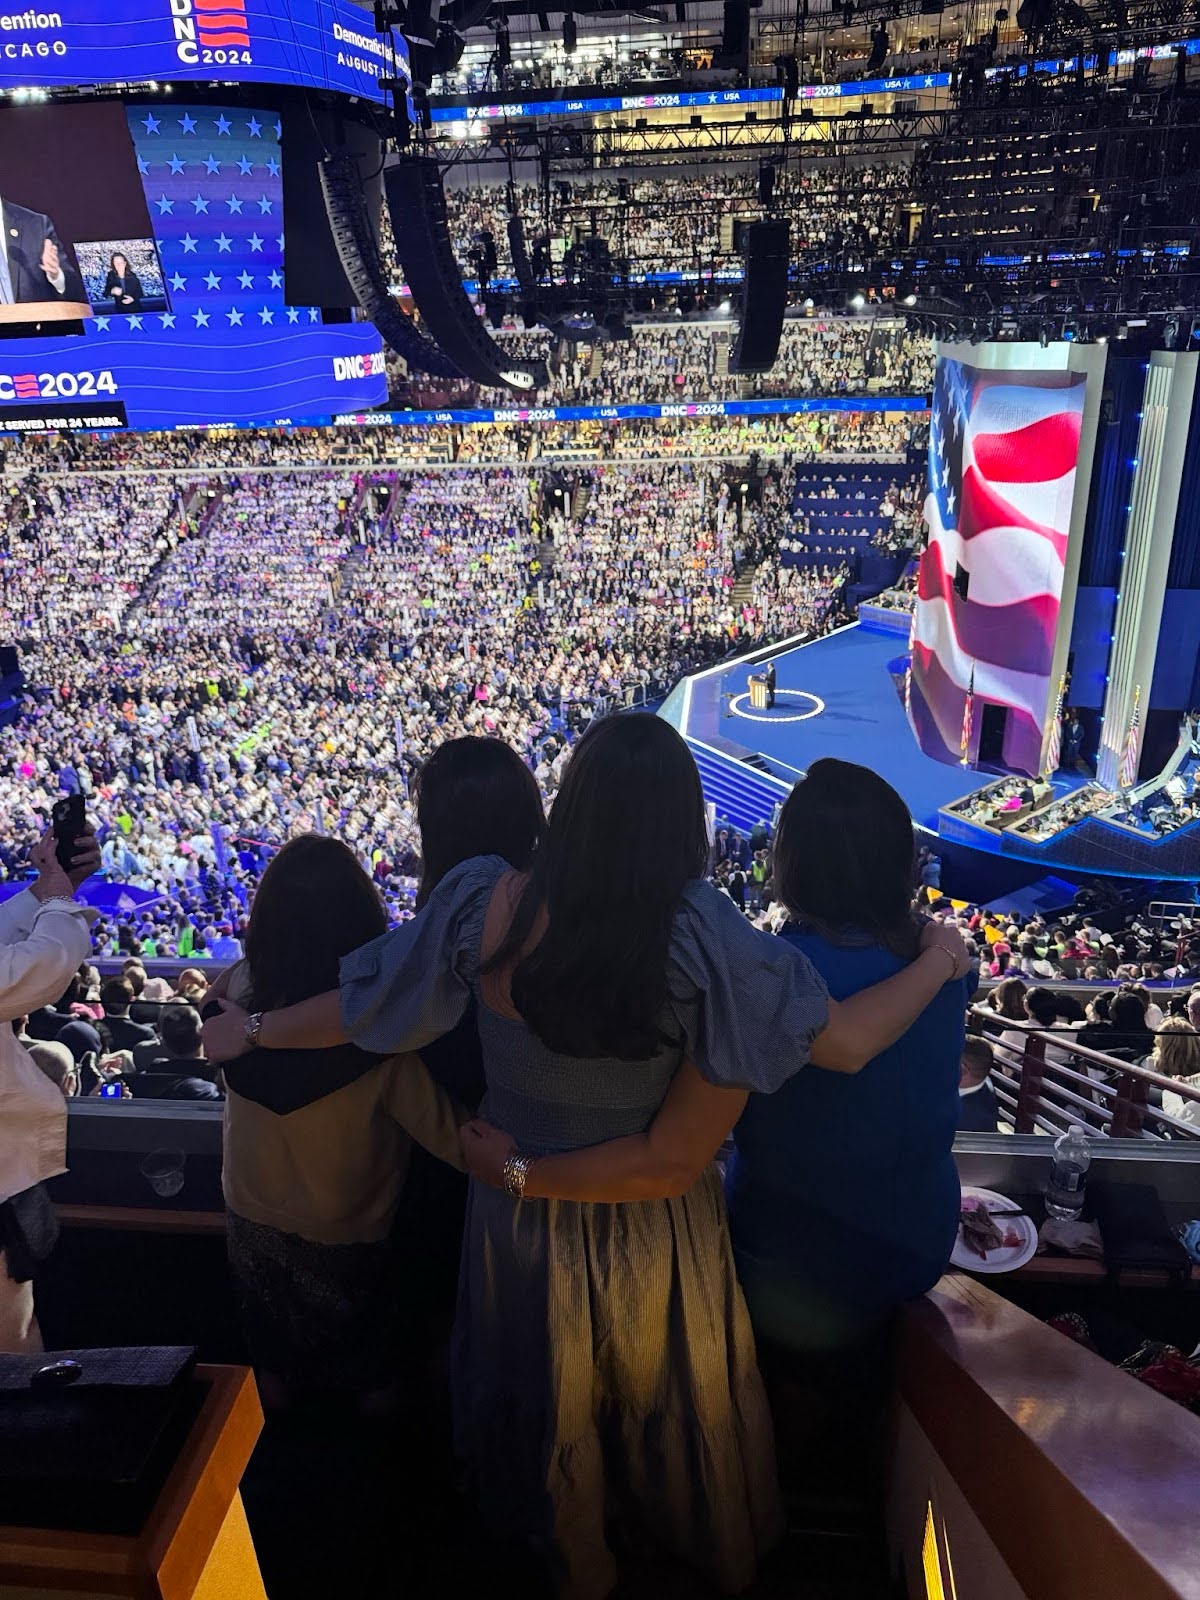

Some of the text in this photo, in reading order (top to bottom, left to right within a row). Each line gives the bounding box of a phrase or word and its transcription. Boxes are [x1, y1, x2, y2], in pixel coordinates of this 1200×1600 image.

[0, 9, 62, 31] ention
[0, 40, 67, 58] CAGO
[201, 49, 253, 65] 2024
[337, 51, 379, 78] AUGUST
[814, 85, 841, 96] 2024
[885, 80, 902, 90] USA
[653, 95, 680, 107] 2024
[723, 92, 740, 101] USA
[567, 102, 583, 110] USA
[333, 354, 365, 382] DNC
[38, 370, 118, 398] 2024
[493, 409, 556, 421] DNC 2024
[600, 408, 619, 417] USA
[661, 403, 726, 416] DNC 2024
[4, 419, 45, 431] SERVED
[45, 418, 68, 430] FOR
[68, 418, 82, 429] 24
[83, 416, 123, 428] YEARS.
[364, 413, 392, 425] 2024
[435, 413, 453, 422] USA
